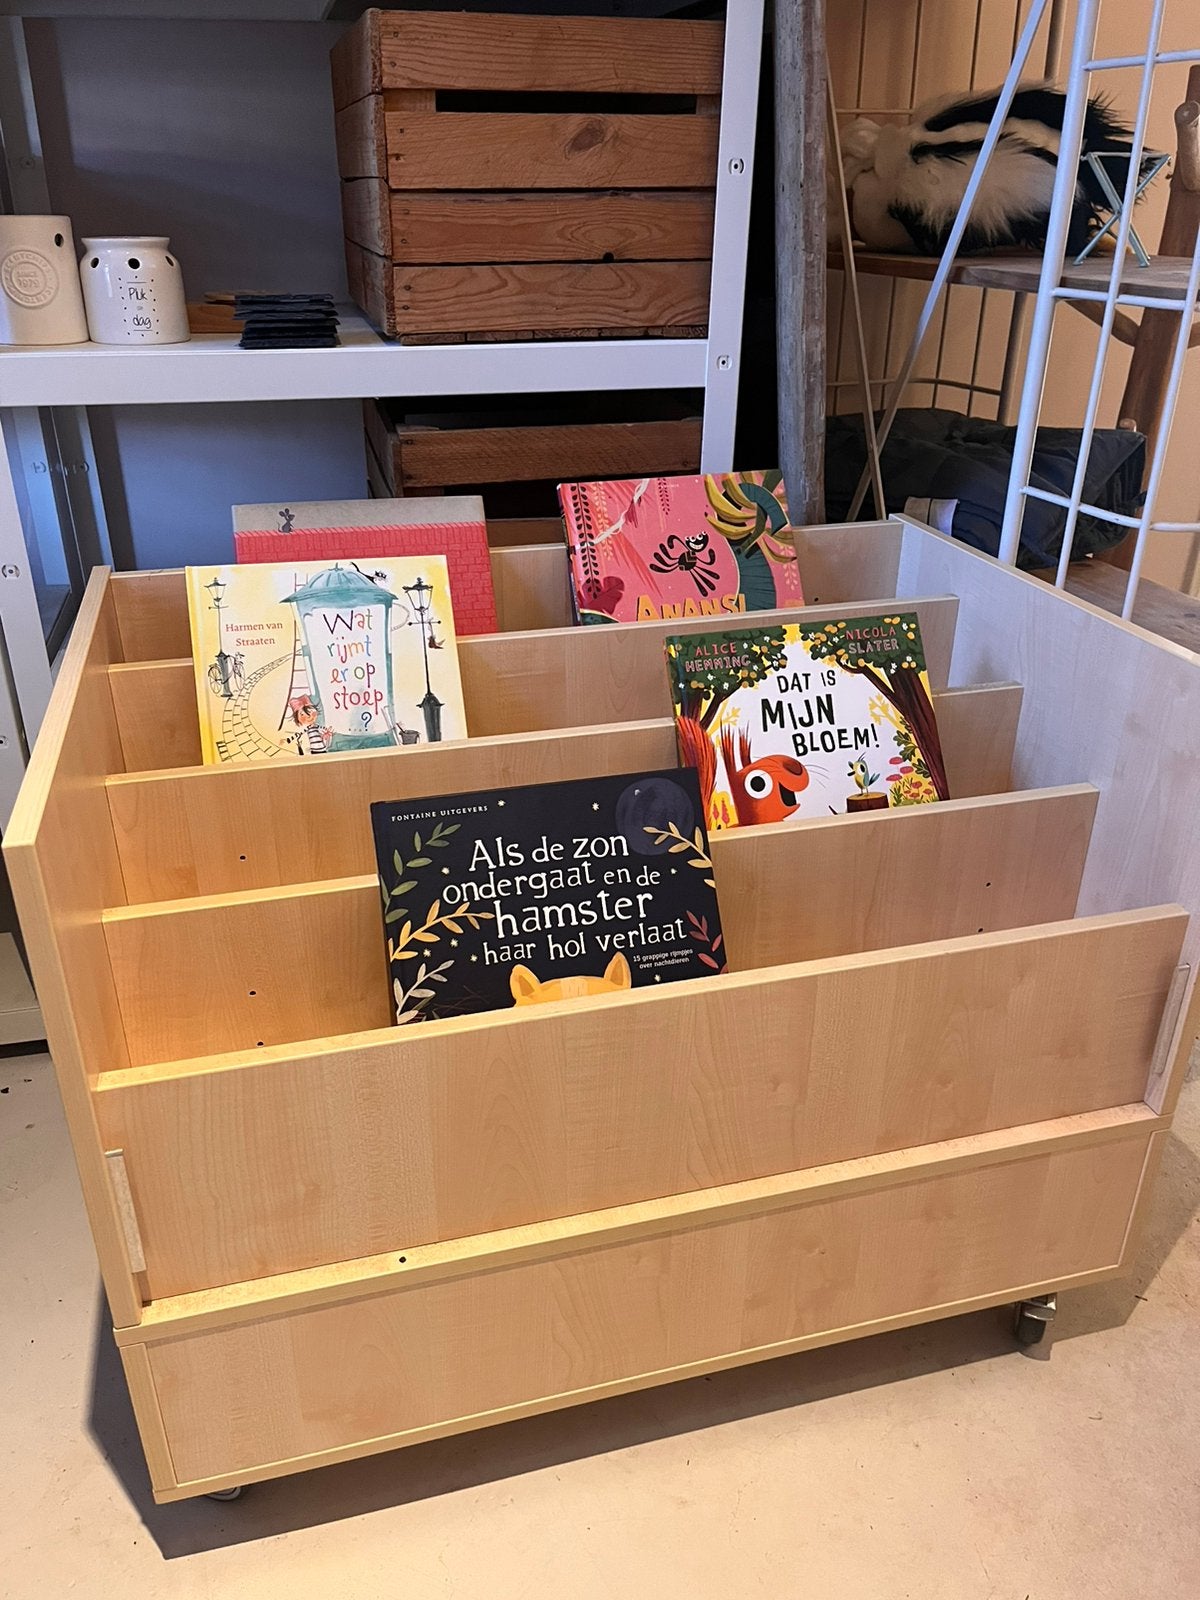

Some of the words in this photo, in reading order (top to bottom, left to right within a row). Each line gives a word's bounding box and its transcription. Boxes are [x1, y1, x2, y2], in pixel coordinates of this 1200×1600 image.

[132, 314, 152, 329] dag
[636, 593, 746, 623] ANANSI
[225, 622, 264, 633] Harmen
[266, 622, 283, 631] van
[323, 608, 373, 635] Wat
[845, 626, 897, 640] NICOLA
[235, 636, 276, 647] Straaten
[327, 634, 372, 664] rijmt
[695, 642, 738, 657] ALICE
[848, 638, 899, 654] SLATER
[330, 668, 348, 683] er
[354, 662, 376, 688] op
[685, 654, 751, 673] HEMMING
[777, 672, 811, 694] DAT
[821, 670, 836, 687] IS
[333, 686, 384, 715] stoep
[760, 693, 836, 732] MIJN
[792, 723, 880, 757] BLOEM!
[391, 811, 437, 822] FONTAINE
[440, 805, 488, 817] UITGEVERS
[468, 836, 525, 872] Als
[531, 836, 563, 863] de
[572, 835, 629, 858] zon
[442, 861, 595, 905] ondergaat
[603, 867, 631, 885] en
[636, 866, 661, 887] de
[493, 890, 653, 939] hamster
[483, 941, 537, 965] haar
[548, 932, 587, 961] hol
[595, 918, 687, 952] verlaat
[642, 952, 669, 962] grappige
[670, 948, 693, 957] rijmpjes
[654, 957, 690, 967] nachtdieren
